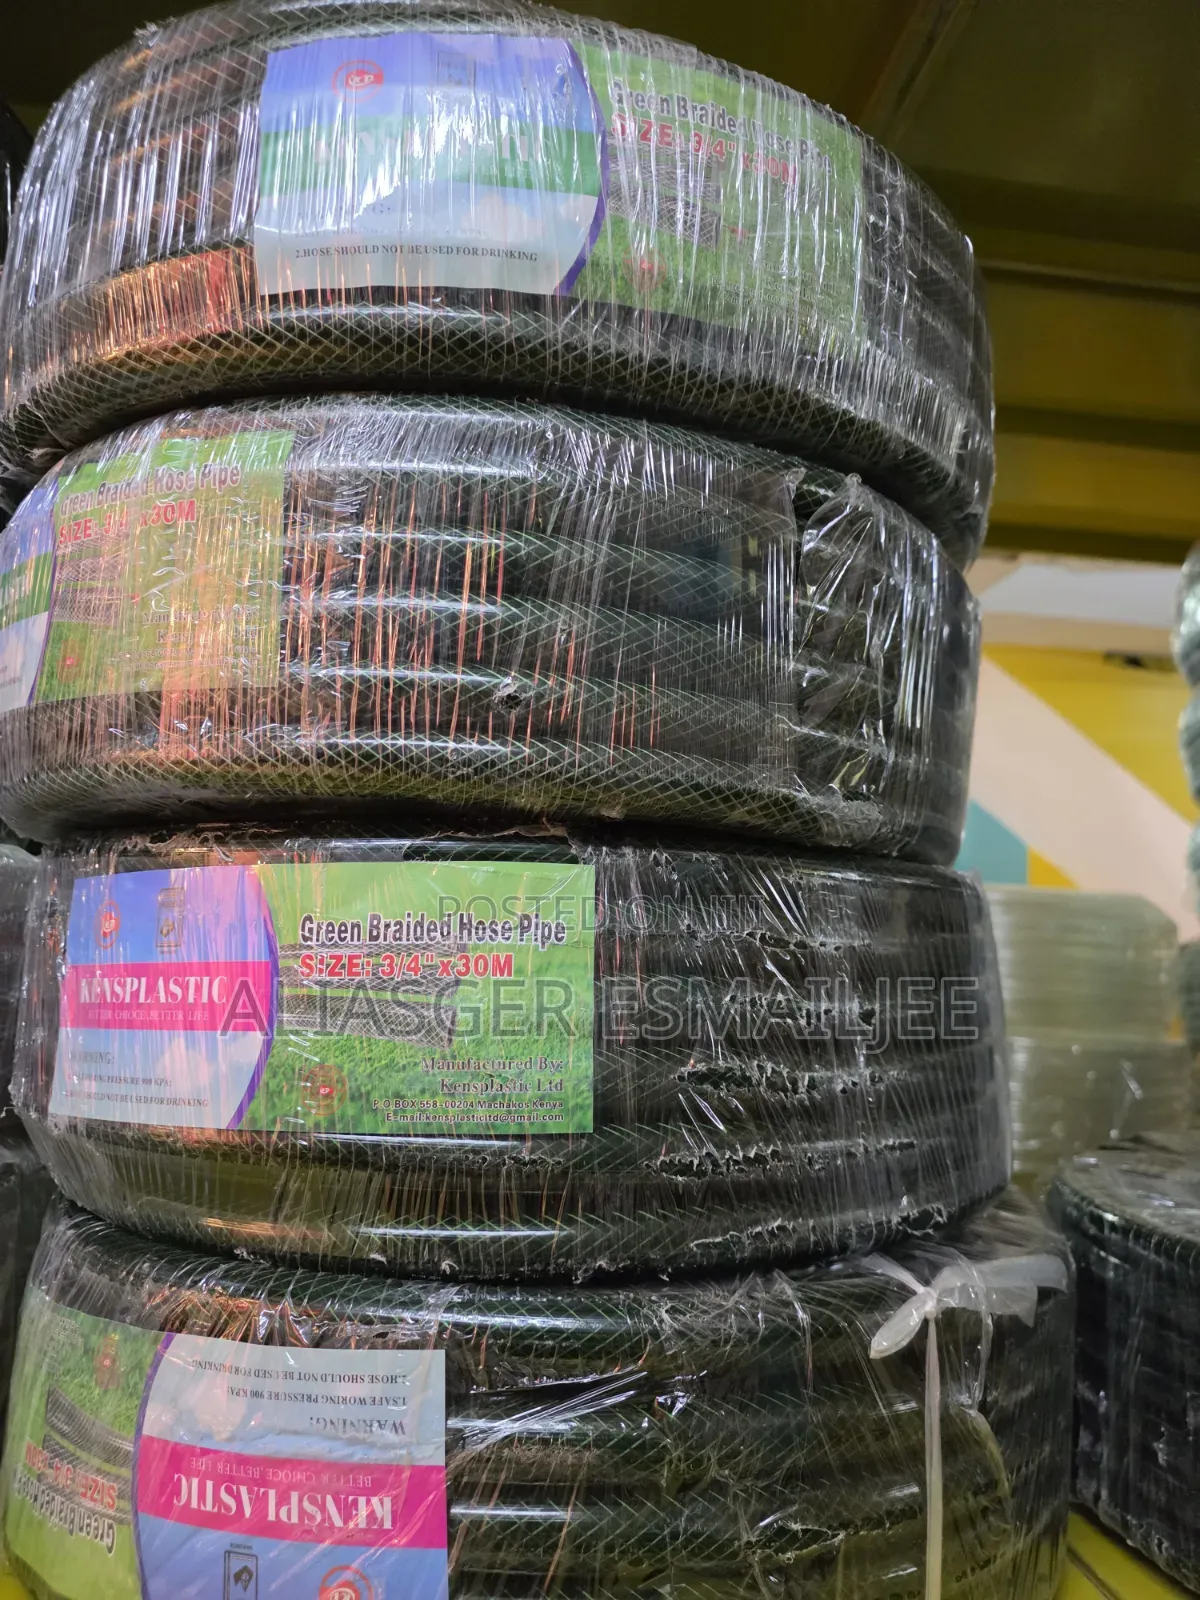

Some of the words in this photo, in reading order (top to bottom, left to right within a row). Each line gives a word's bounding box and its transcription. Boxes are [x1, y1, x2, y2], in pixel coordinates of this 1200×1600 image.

[611, 78, 671, 117] Green
[676, 94, 748, 139] Braided
[295, 245, 333, 258] 2.HOSE
[334, 244, 380, 255] SHOULD
[381, 244, 405, 254] NOT
[408, 244, 423, 254] BE
[424, 245, 455, 255] USED
[456, 246, 479, 257] FOR
[481, 247, 539, 262] DRINKING
[151, 466, 197, 495] Hose
[200, 462, 241, 494] Pipe
[300, 912, 362, 944] Green
[367, 912, 451, 944] Braided
[458, 912, 513, 944] Hose
[518, 912, 567, 951] Pipe
[299, 952, 373, 978] SIZE:
[79, 976, 228, 1004] KENSPLASTIC
[188, 1010, 209, 1021] LIFE
[421, 1056, 533, 1071] Manufactured
[538, 1056, 563, 1074] By:
[439, 1079, 532, 1095] Kensplastic
[537, 1078, 563, 1092] Ltd
[150, 1096, 165, 1105] FOR
[166, 1097, 210, 1107] DRINKING
[419, 1100, 475, 1110] 558-00204
[477, 1100, 530, 1110] Machakos
[532, 1100, 563, 1110] Kenya
[191, 1359, 233, 1375] DRINKING
[233, 1366, 251, 1377] FOR
[253, 1369, 279, 1380] USED
[281, 1370, 294, 1381] BE
[297, 1372, 319, 1382] NOT
[321, 1373, 366, 1384] SHOULD
[367, 1374, 407, 1384] 2.HOSE
[227, 1386, 248, 1398] KPA:
[249, 1389, 265, 1399] 900
[266, 1391, 319, 1404] PRESSURE
[321, 1394, 367, 1406] WORING
[369, 1396, 406, 1407] 1.SAFE
[309, 1416, 406, 1436] WARNING:
[189, 1457, 212, 1472] LIFE
[173, 1473, 393, 1530] KENSPLASTIC
[79, 1507, 117, 1558] Green
